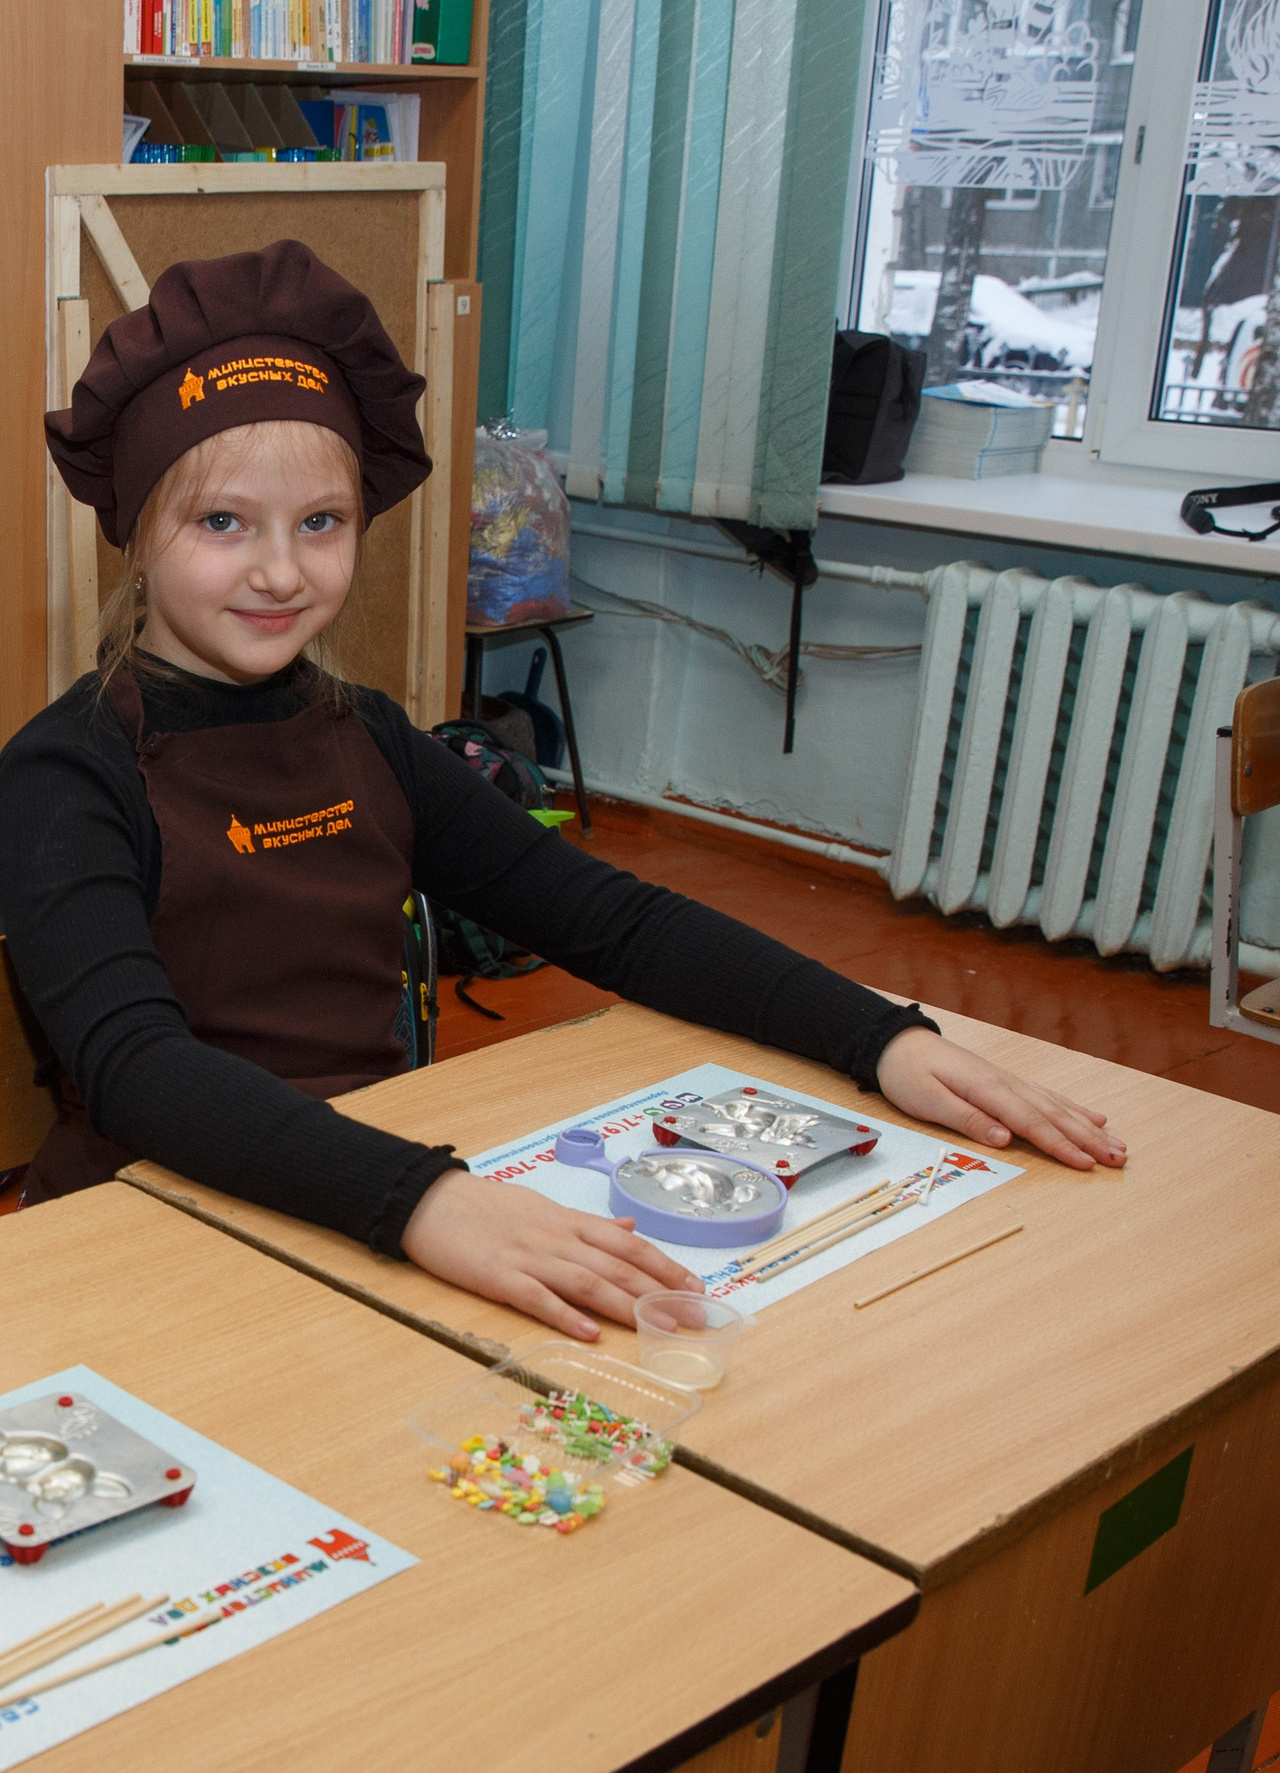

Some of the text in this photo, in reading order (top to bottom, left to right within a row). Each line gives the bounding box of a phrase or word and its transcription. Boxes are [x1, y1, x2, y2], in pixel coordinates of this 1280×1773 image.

[207, 357, 329, 384] МИНИСТЕРСТВО
[216, 370, 325, 394] ВКУСНЫХ ДЕЛ
[253, 799, 355, 835] МИНИСТЕРСТВО
[262, 818, 352, 849] ВКУСНЫХ ДЕЛ
